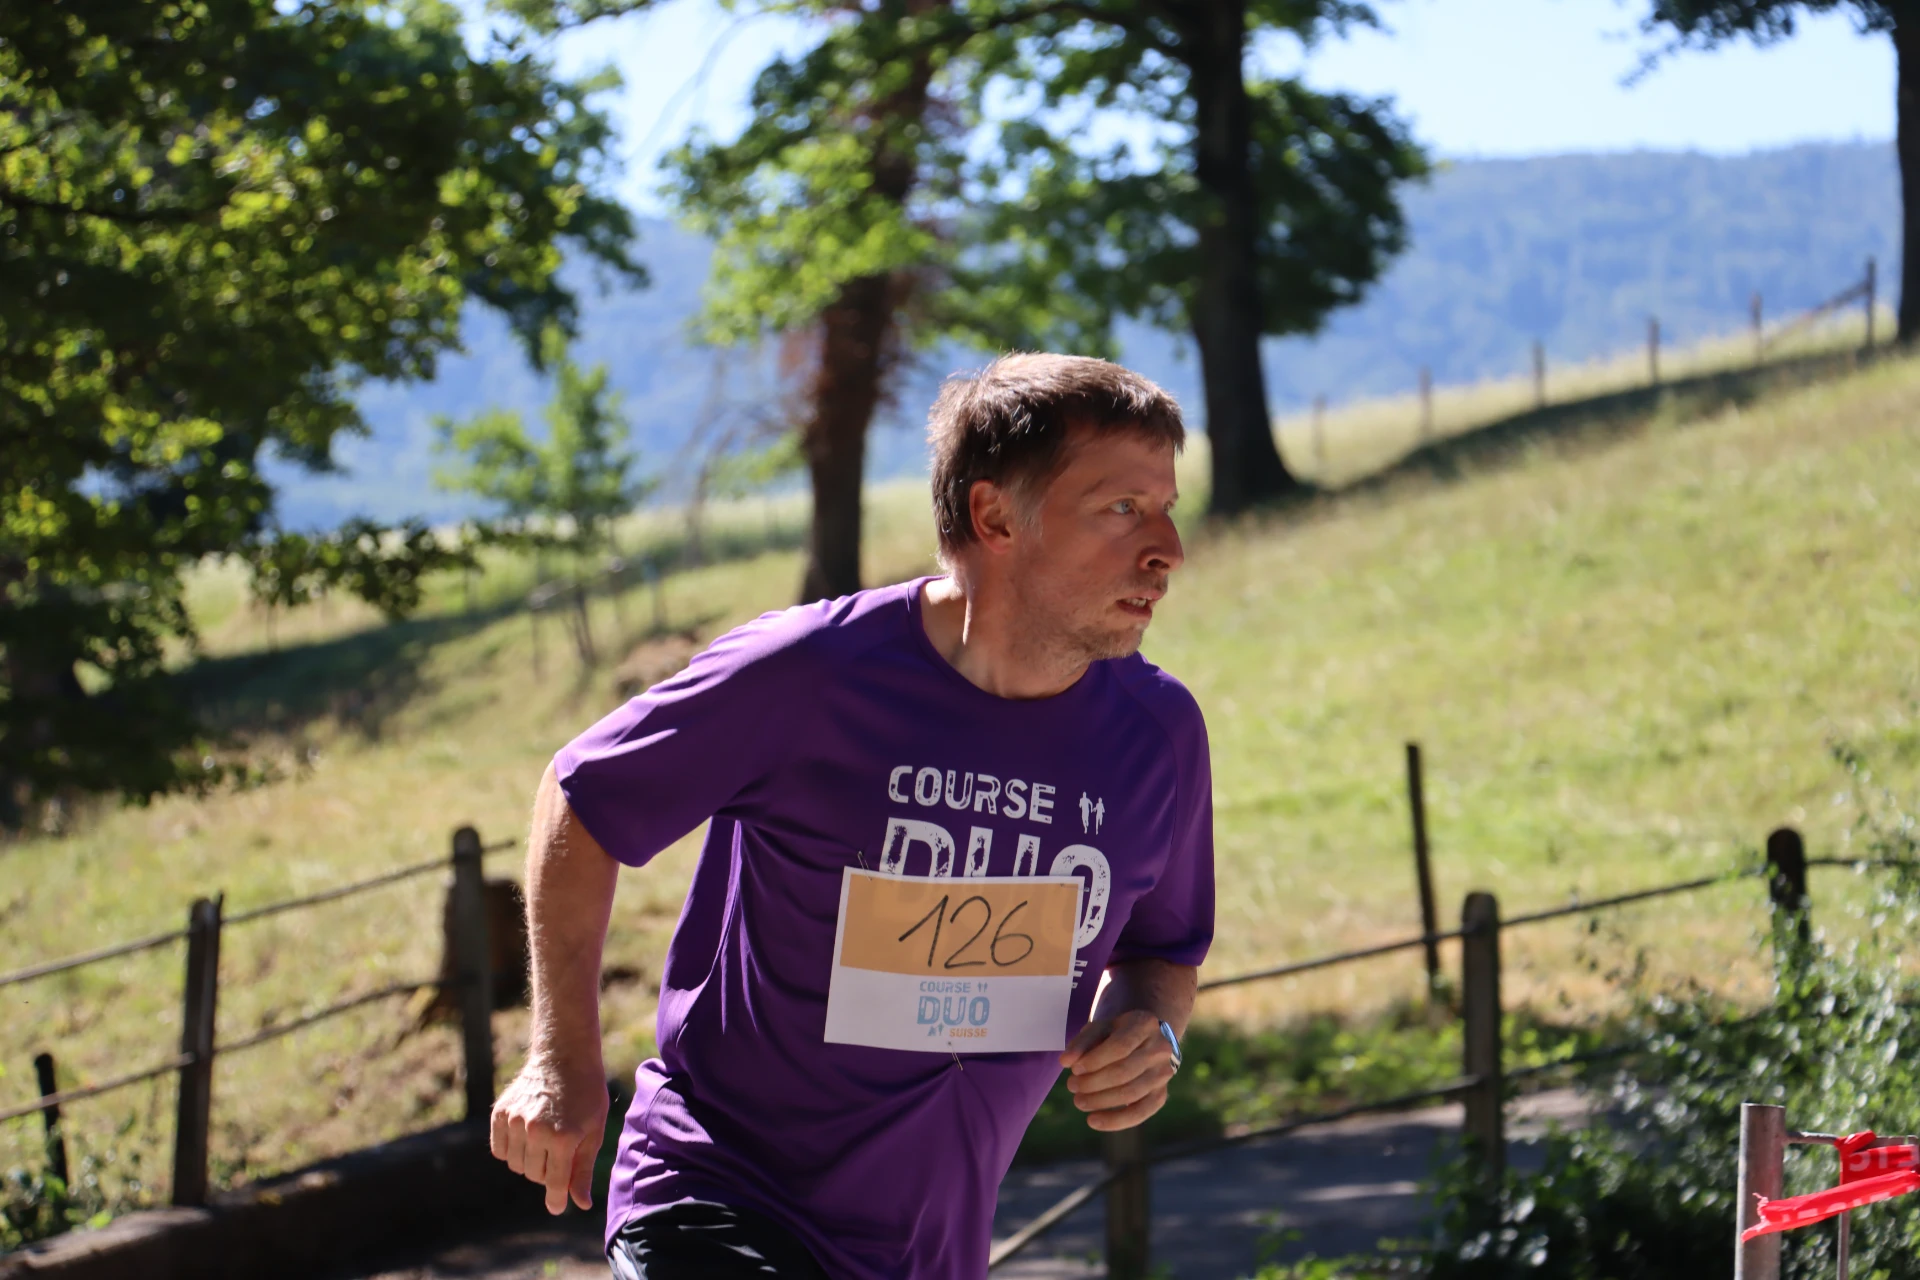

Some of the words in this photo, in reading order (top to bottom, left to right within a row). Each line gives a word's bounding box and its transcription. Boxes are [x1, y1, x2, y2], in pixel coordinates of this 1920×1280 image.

[888, 765, 1056, 824] COURSE
[898, 894, 1034, 969] 126
[919, 981, 972, 993] COURSE
[917, 996, 990, 1026] DUO
[950, 1028, 988, 1038] SUISSE
